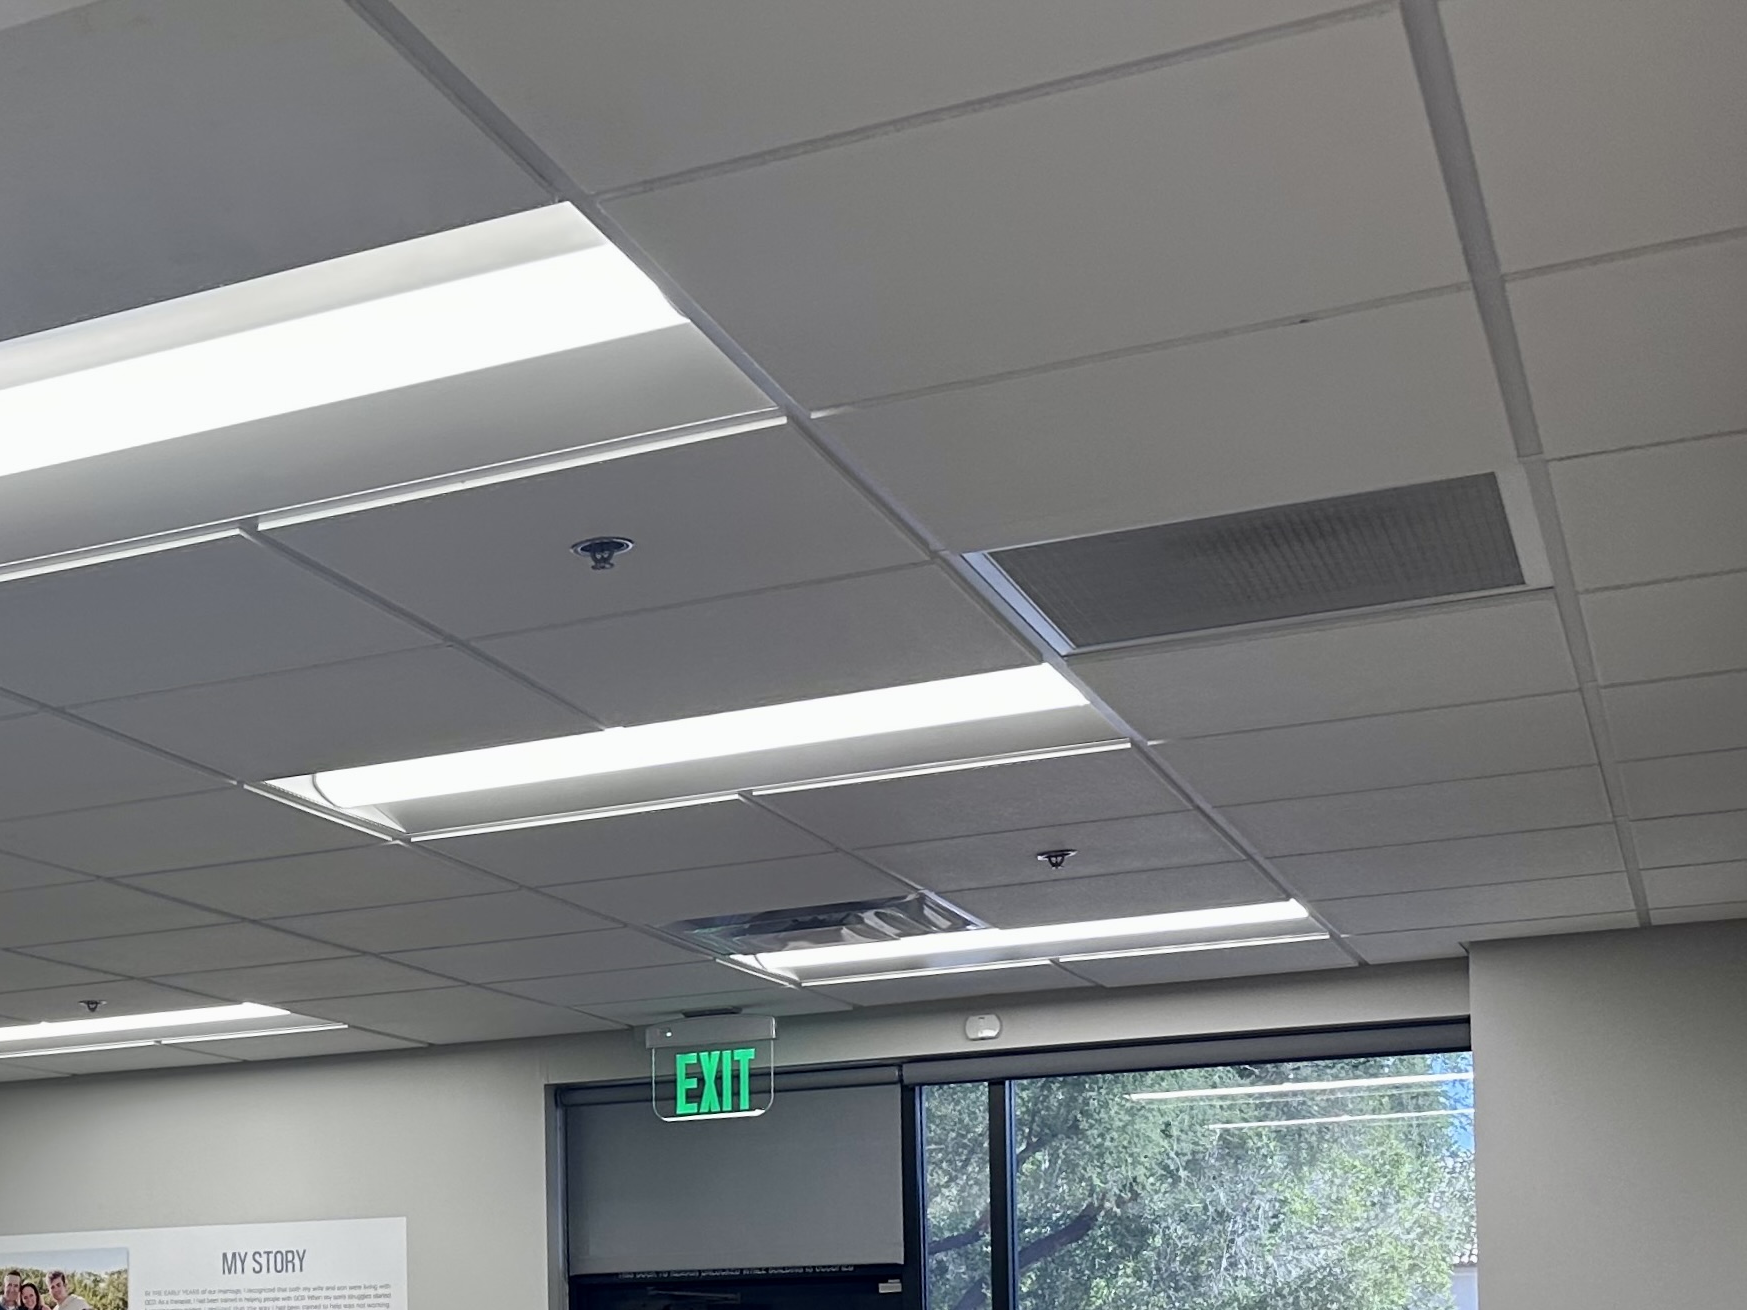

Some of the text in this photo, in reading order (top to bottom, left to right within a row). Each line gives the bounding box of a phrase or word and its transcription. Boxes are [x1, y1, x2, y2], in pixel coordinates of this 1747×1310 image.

[675, 1048, 755, 1115] EXIT
[222, 1249, 307, 1275] MY STORY
